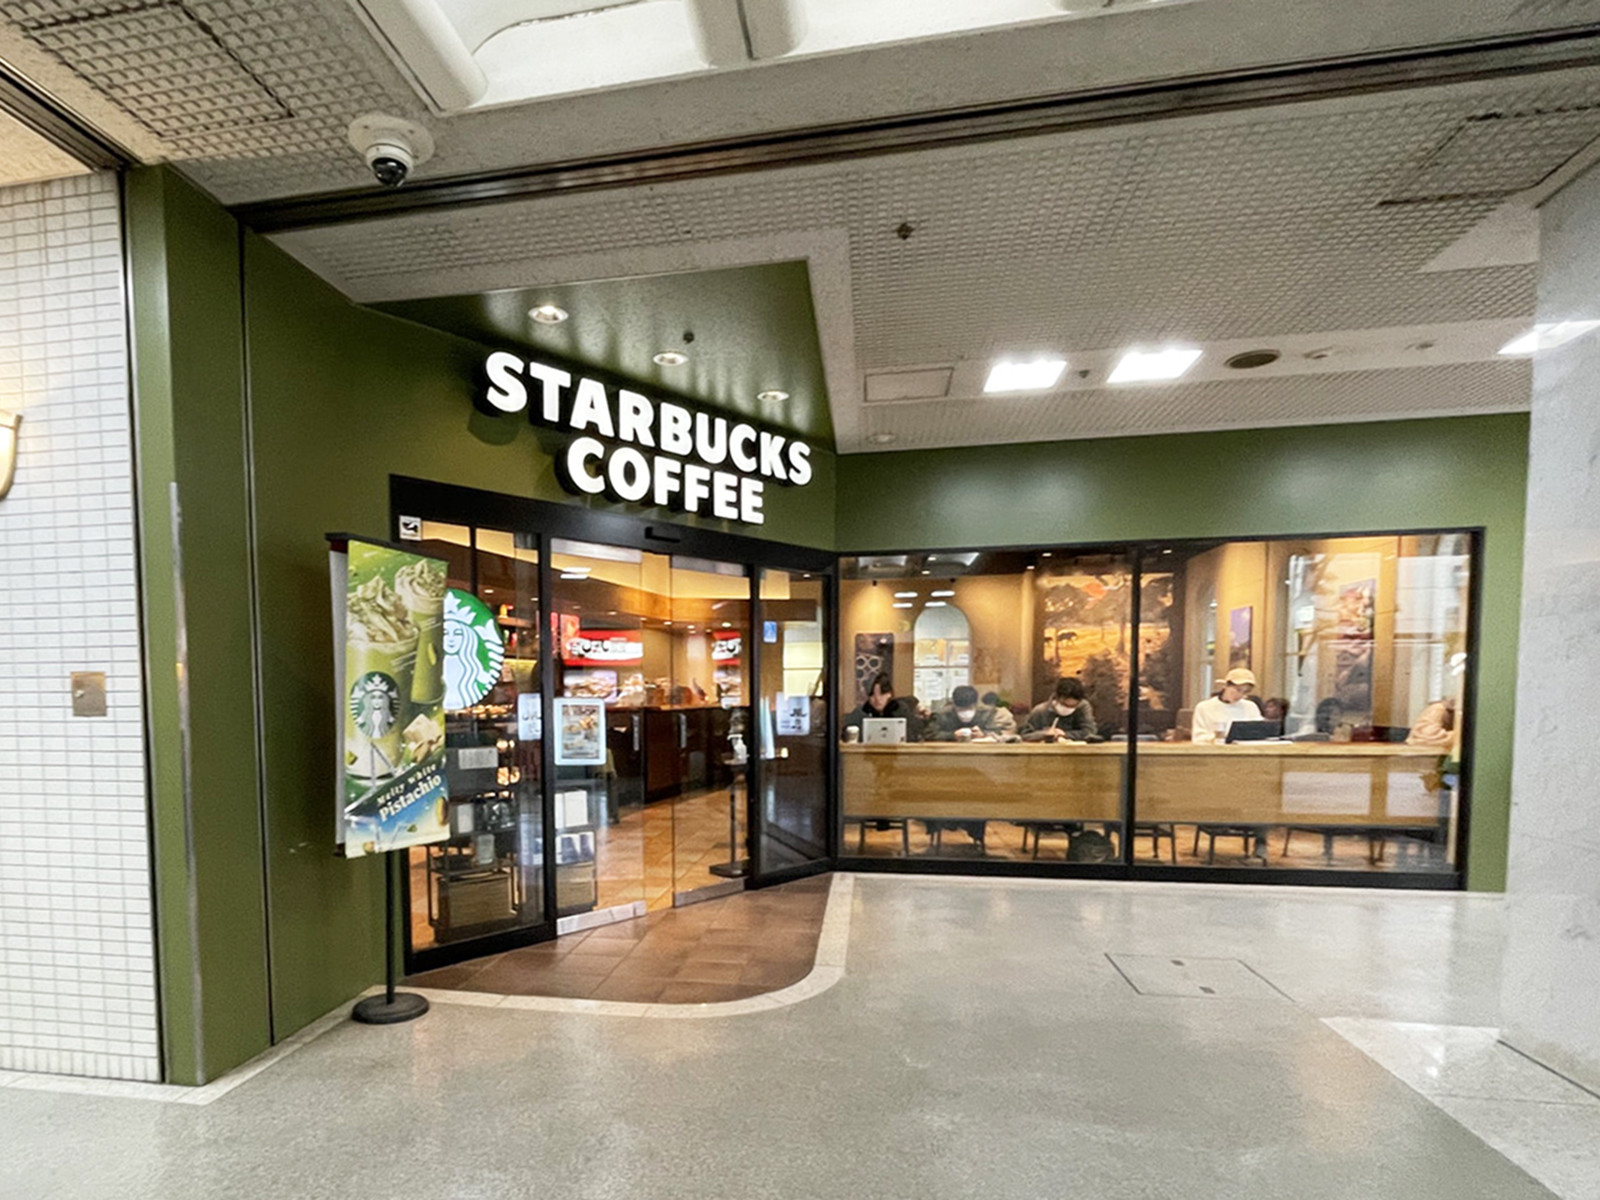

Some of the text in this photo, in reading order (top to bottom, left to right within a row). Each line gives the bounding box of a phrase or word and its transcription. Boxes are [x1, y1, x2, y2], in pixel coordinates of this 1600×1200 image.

[485, 351, 812, 485] STARBUCKS
[566, 436, 764, 525] COFFEE
[379, 775, 441, 821] Pistachio
